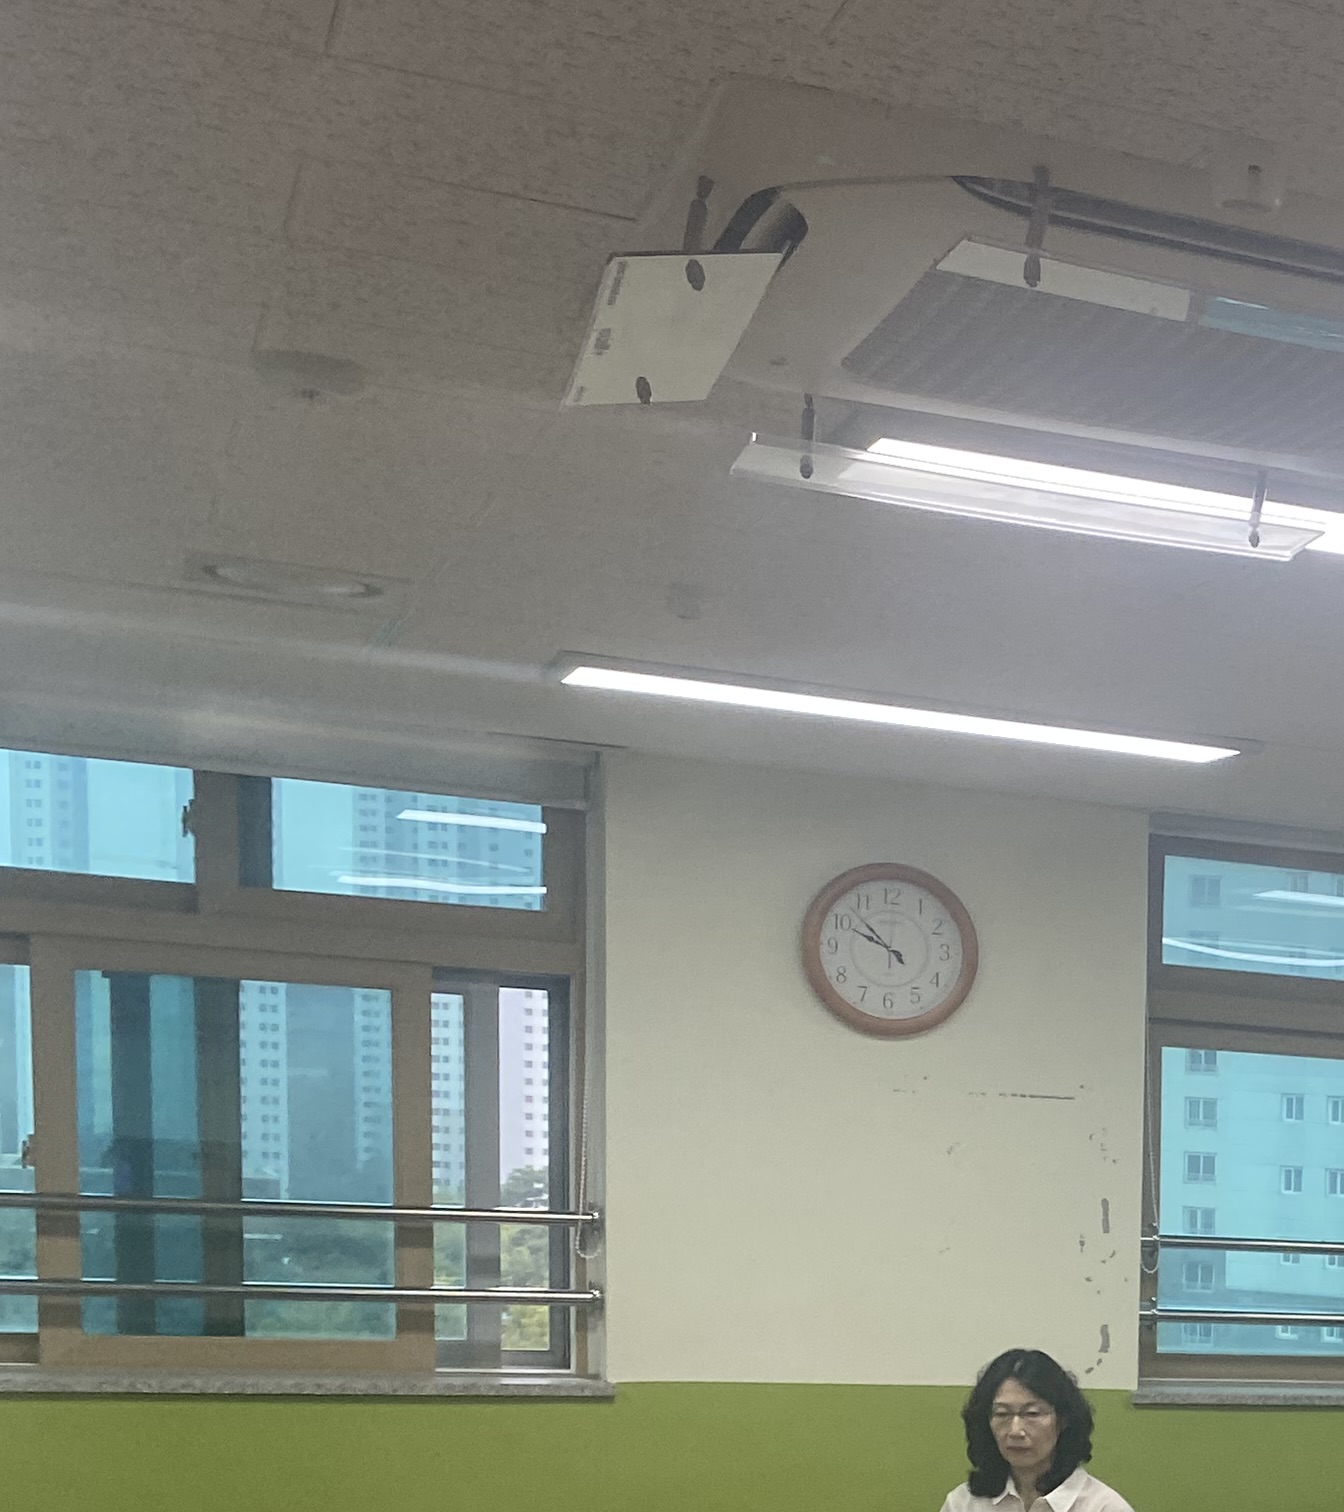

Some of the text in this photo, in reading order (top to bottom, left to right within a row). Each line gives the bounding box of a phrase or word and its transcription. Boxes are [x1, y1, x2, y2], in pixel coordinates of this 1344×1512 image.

[856, 893, 870, 910] 11
[884, 888, 901, 905] 12
[918, 898, 923, 915] 1
[834, 913, 851, 931] 10
[932, 918, 943, 935] 2
[827, 937, 838, 954] 9
[939, 943, 950, 961] 3
[836, 966, 847, 983] 8
[930, 972, 939, 988] 4
[858, 985, 868, 1002] 7
[882, 992, 894, 1009] 6
[910, 987, 921, 1003] 5
